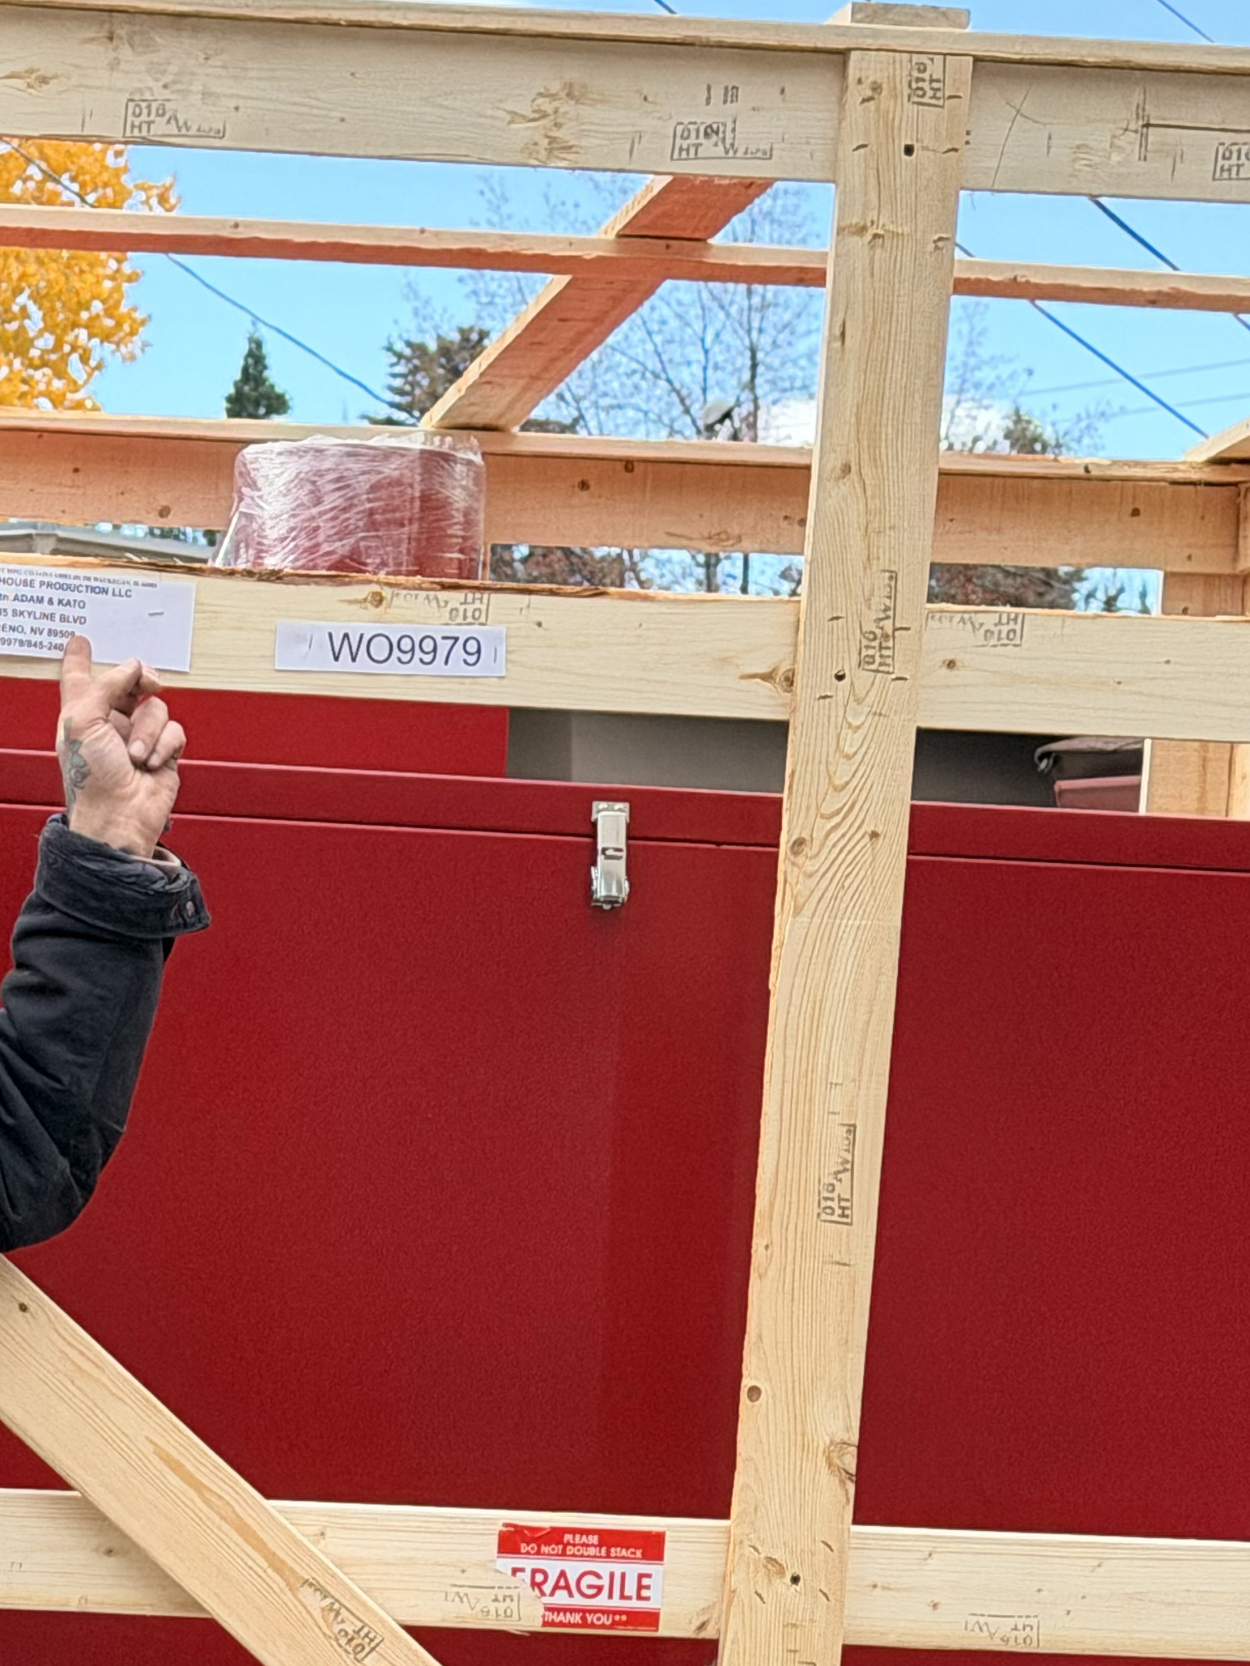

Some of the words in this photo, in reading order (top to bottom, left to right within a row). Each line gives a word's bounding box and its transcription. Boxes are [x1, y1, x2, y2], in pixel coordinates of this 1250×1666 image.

[930, 74, 941, 100] HT
[129, 120, 156, 135] HT
[677, 143, 703, 157] HT
[1219, 164, 1244, 178] HT
[39, 580, 109, 596] PRODUCTION
[111, 587, 133, 599] LLC
[12, 593, 44, 605] ADAM
[47, 597, 54, 606] &
[57, 598, 86, 609] KATO
[460, 592, 484, 605] HT
[11, 608, 56, 622] SKYLINE
[59, 613, 87, 626] BLVD
[994, 613, 1019, 626] HT
[30, 626, 45, 636] NV
[327, 631, 482, 667] WO9979
[878, 641, 891, 668] HT
[838, 1194, 850, 1219] HT
[563, 1533, 599, 1545] PLEASE
[520, 1543, 538, 1554] DO
[540, 1544, 563, 1555] NOT
[566, 1545, 607, 1557] DOUBLE
[610, 1547, 643, 1559] STACK
[543, 1610, 582, 1624] THANK
[351, 1621, 378, 1646] HT
